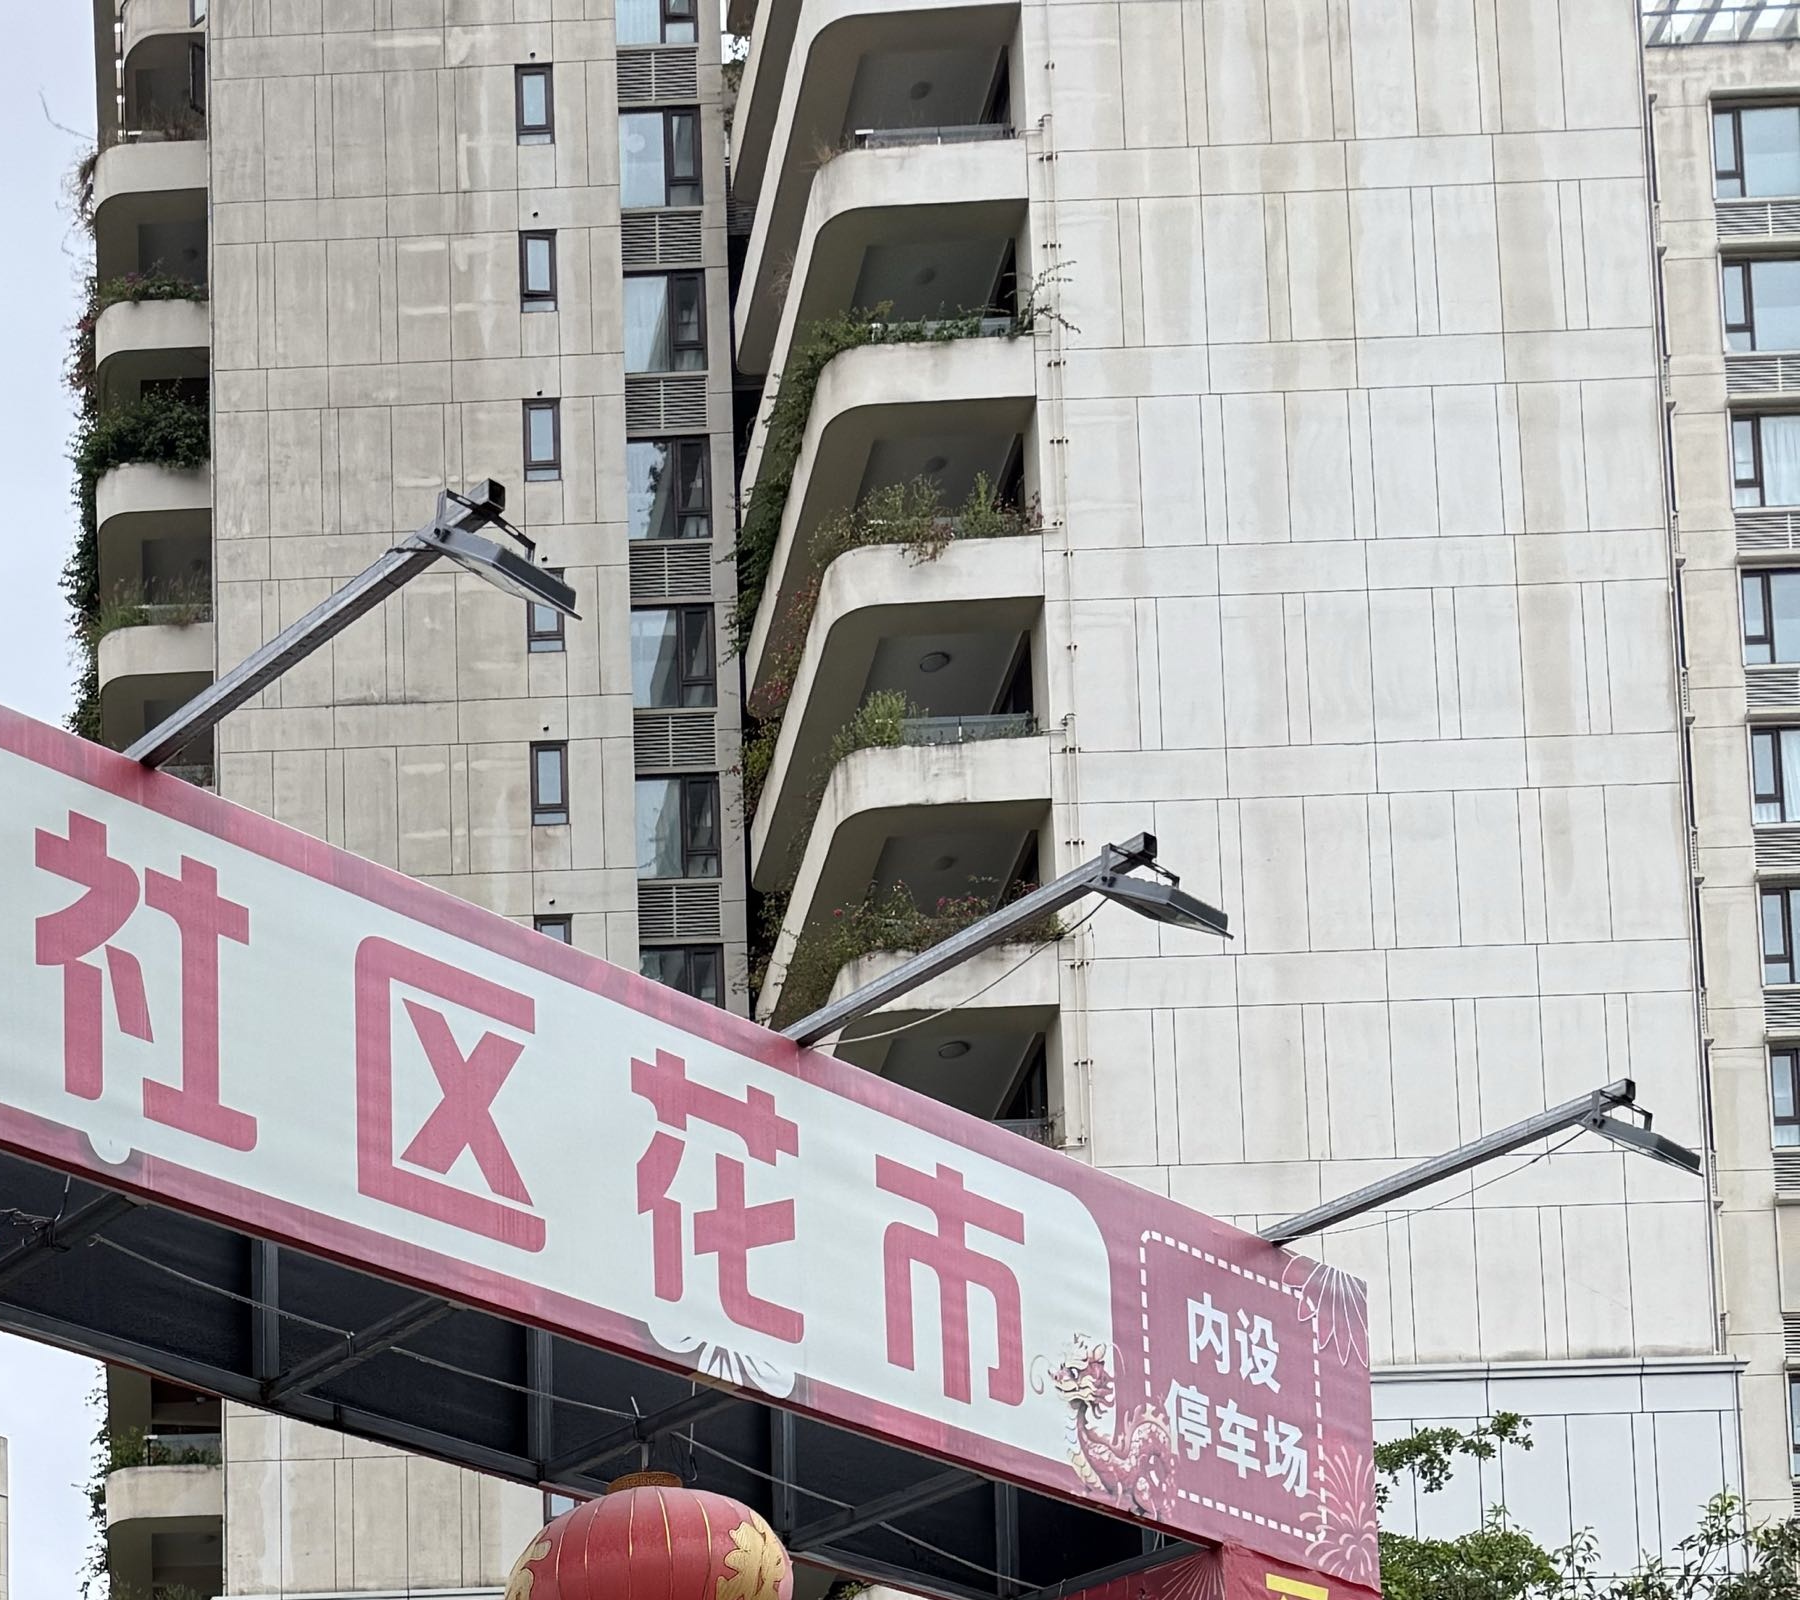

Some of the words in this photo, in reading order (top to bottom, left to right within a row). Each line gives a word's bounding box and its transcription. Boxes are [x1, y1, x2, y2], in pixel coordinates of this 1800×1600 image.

[1186, 1292, 1281, 1394] 内设
[1164, 1379, 1309, 1498] 停车场
